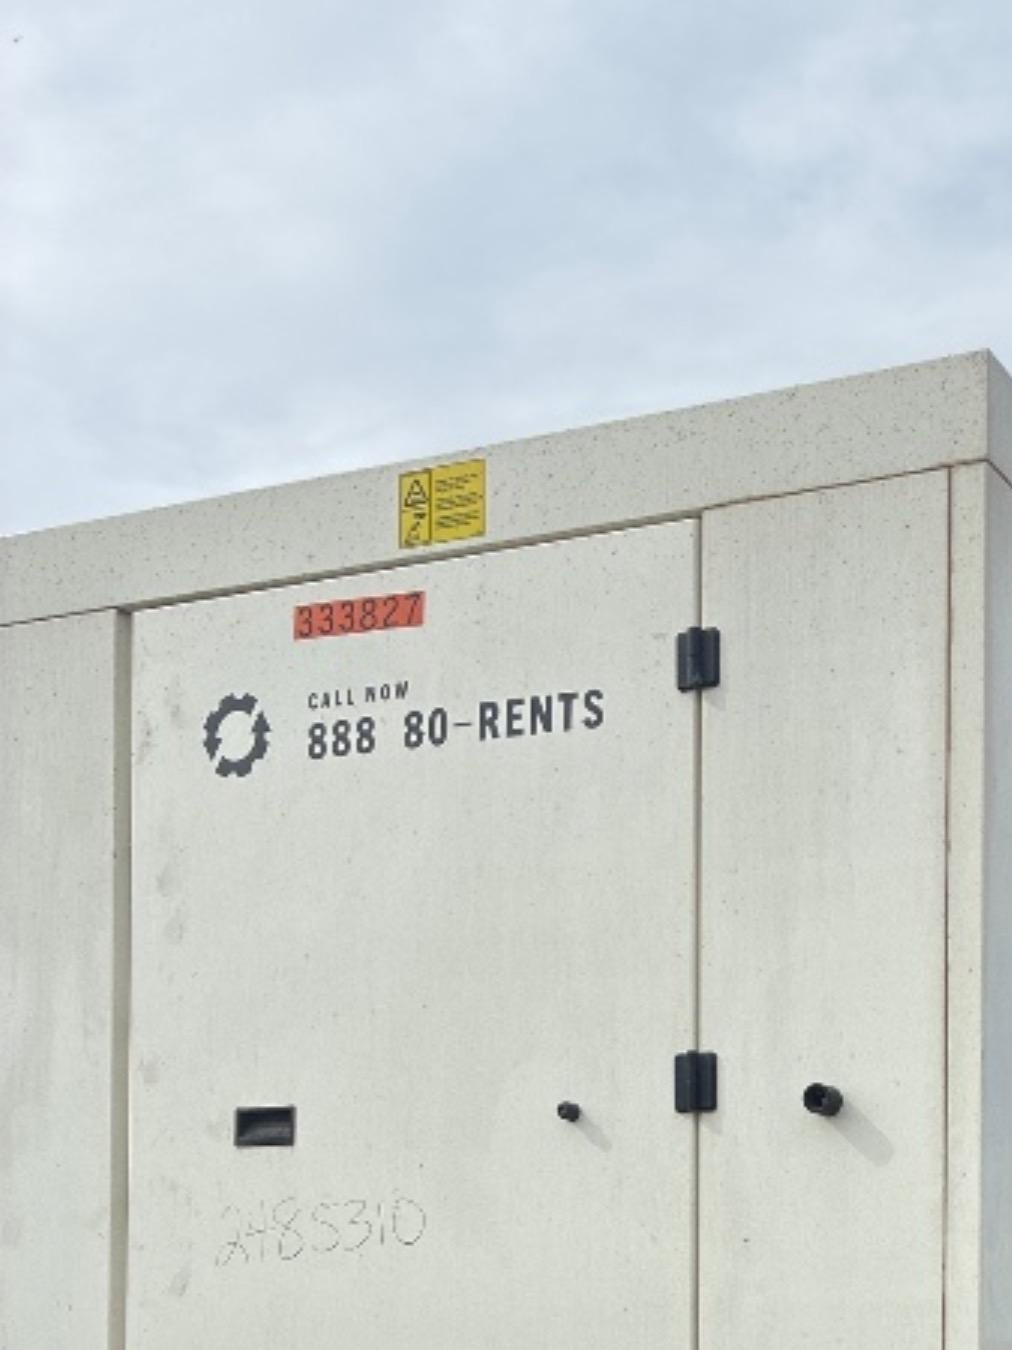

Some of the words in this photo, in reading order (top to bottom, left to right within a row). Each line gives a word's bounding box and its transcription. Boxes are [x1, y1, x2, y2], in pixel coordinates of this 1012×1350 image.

[298, 589, 423, 640] 333827
[307, 689, 355, 709] CALL
[364, 680, 409, 703] NOW
[307, 715, 377, 760] 888
[403, 689, 605, 749] 80-RENTS
